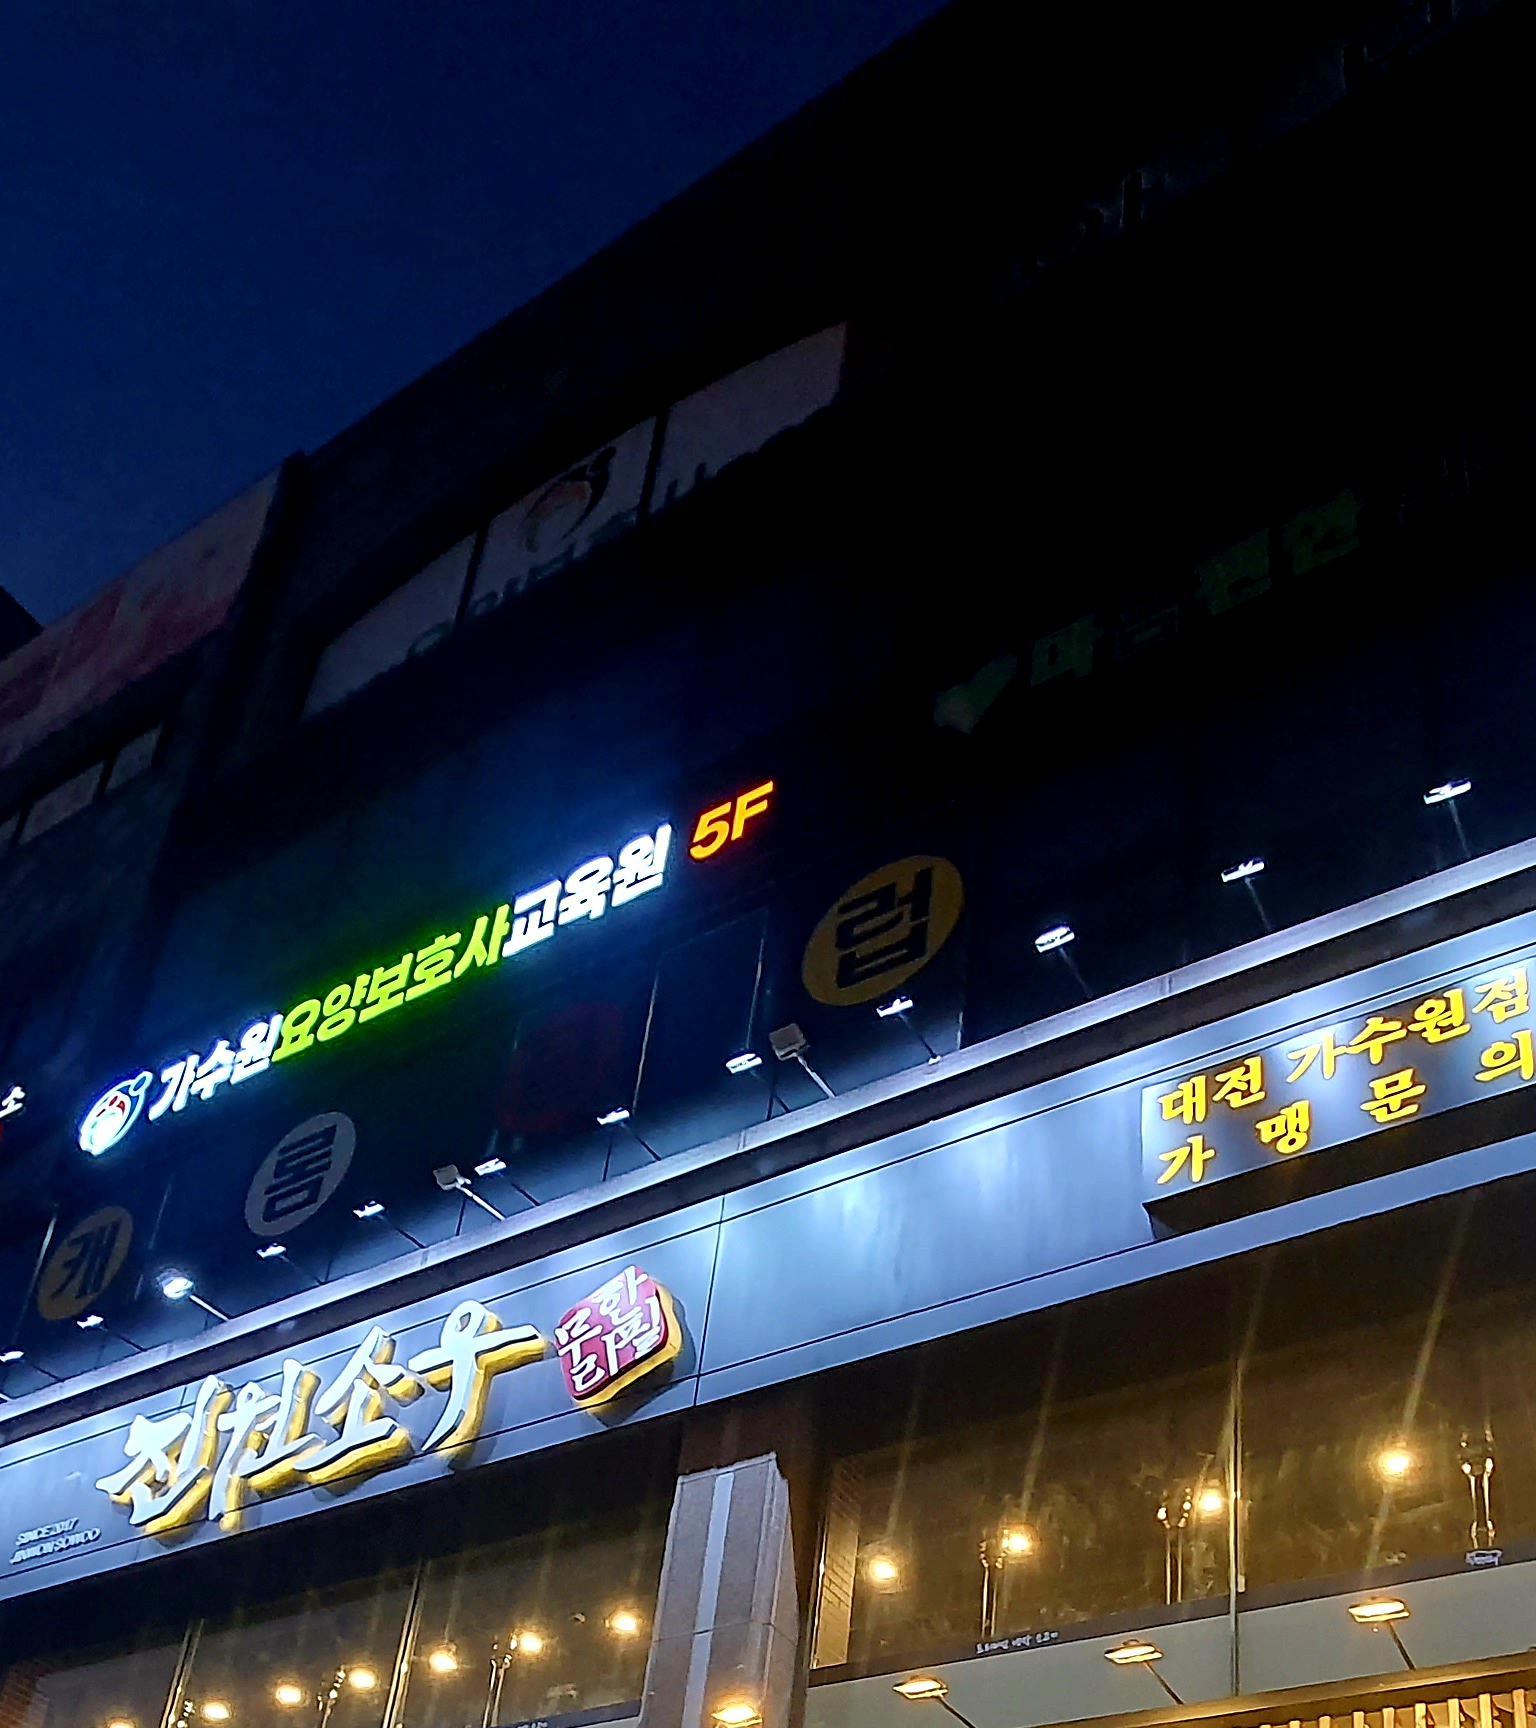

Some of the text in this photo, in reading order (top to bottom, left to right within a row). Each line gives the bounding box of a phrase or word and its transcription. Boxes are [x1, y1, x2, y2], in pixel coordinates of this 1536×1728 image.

[689, 780, 775, 863] 5F
[1157, 967, 1534, 1128] 대전 가수원점
